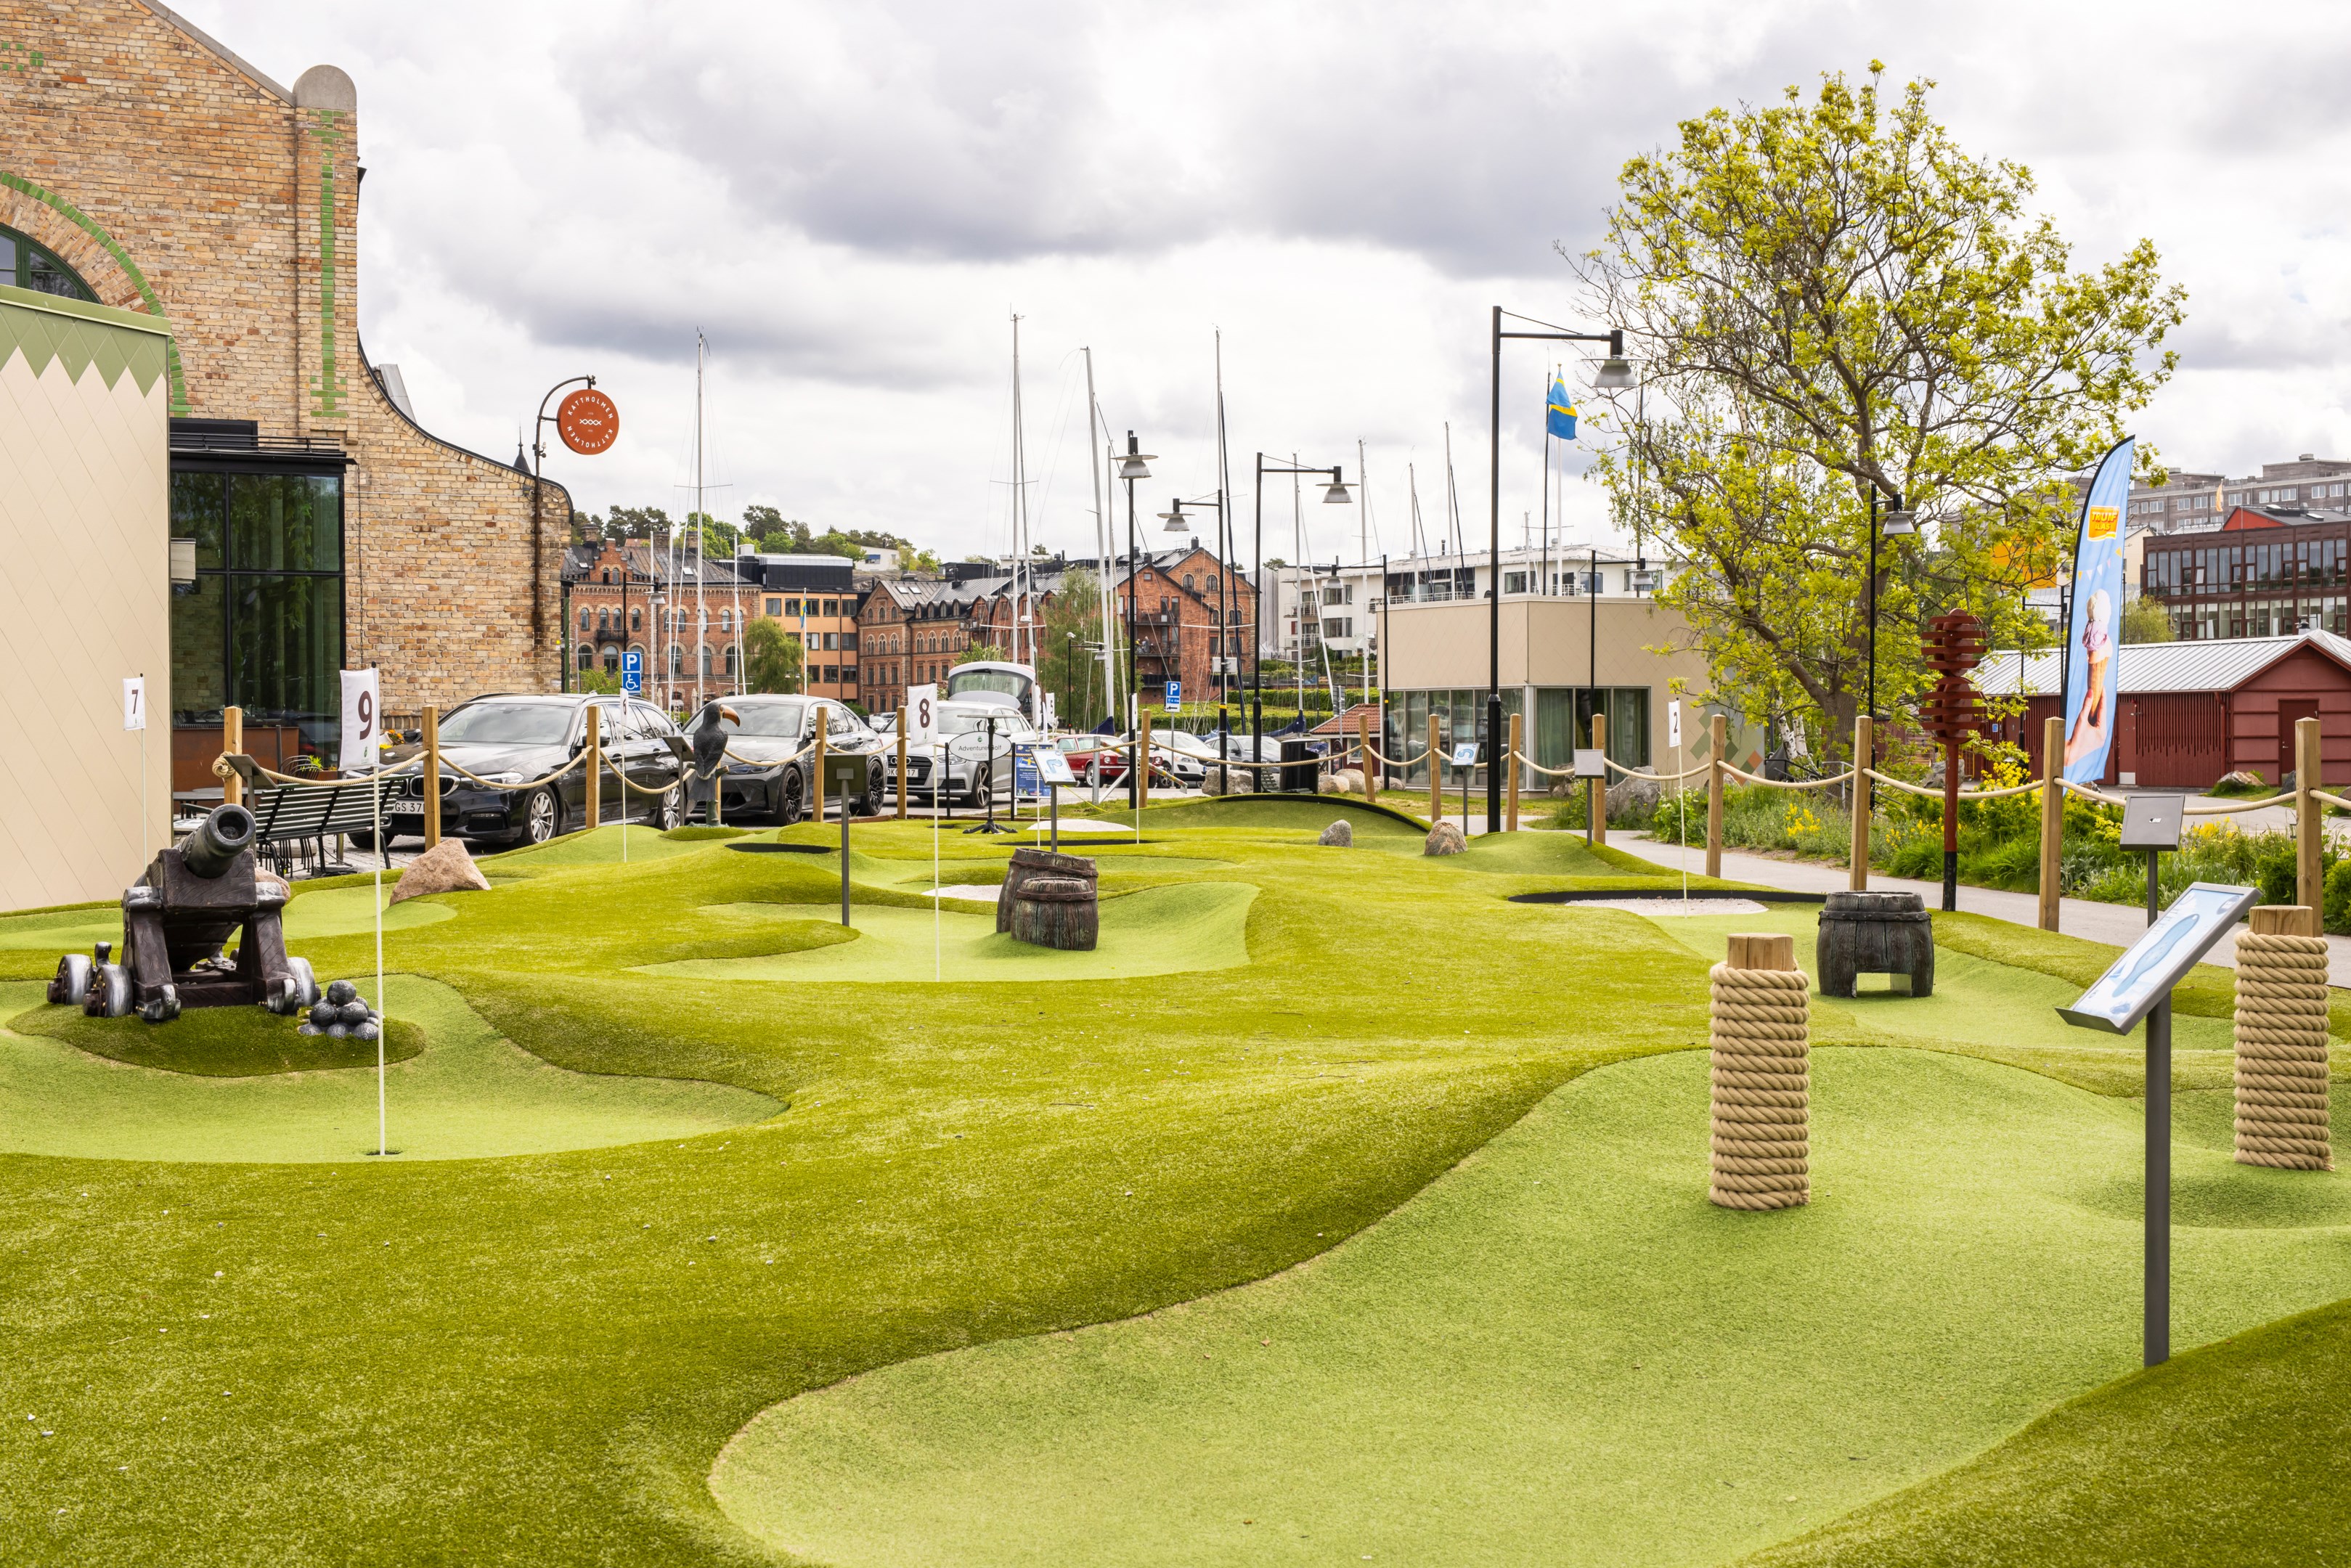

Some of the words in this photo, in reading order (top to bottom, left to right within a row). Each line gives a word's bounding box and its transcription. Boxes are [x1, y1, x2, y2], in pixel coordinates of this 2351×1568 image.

[568, 396, 614, 419] KATTHOLMEN
[567, 425, 613, 448] KATTHOLMEN
[627, 654, 637, 670] P
[1170, 683, 1178, 695] P
[131, 689, 139, 714] 7
[919, 698, 931, 728] 8
[358, 690, 372, 740] 9
[1674, 711, 1678, 733] 2
[395, 802, 407, 812] GS
[410, 803, 425, 812] 37
